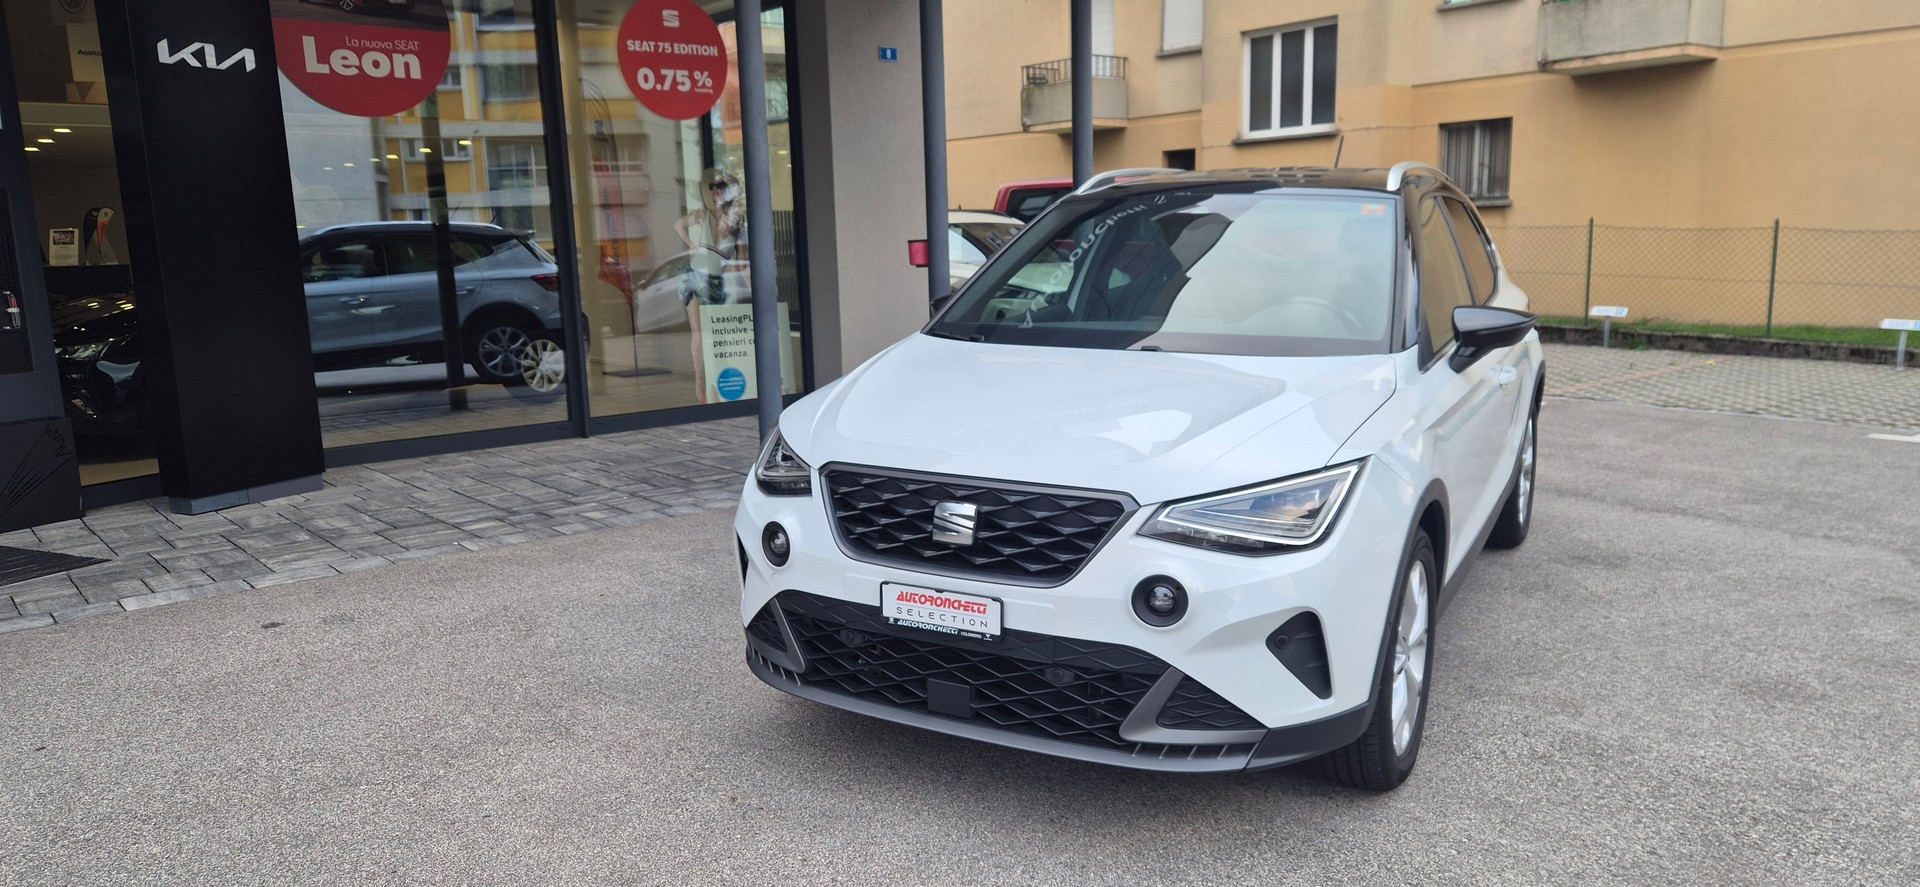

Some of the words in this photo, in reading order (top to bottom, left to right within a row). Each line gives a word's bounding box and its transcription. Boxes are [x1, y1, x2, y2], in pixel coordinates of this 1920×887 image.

[345, 35, 359, 47] La
[361, 40, 393, 49] nuova
[394, 40, 420, 51] SEAT
[626, 40, 656, 52] SEAT
[657, 42, 672, 54] 75
[674, 43, 718, 56] EDITION
[302, 35, 421, 79] Leon
[712, 327, 748, 335] inclusive
[713, 338, 746, 348] pensieri
[714, 350, 750, 359] vacanza.
[896, 591, 988, 615] AUTORONCHETTI
[896, 606, 988, 628] SELECTION
[897, 619, 958, 635] AUTORONCHETTI
